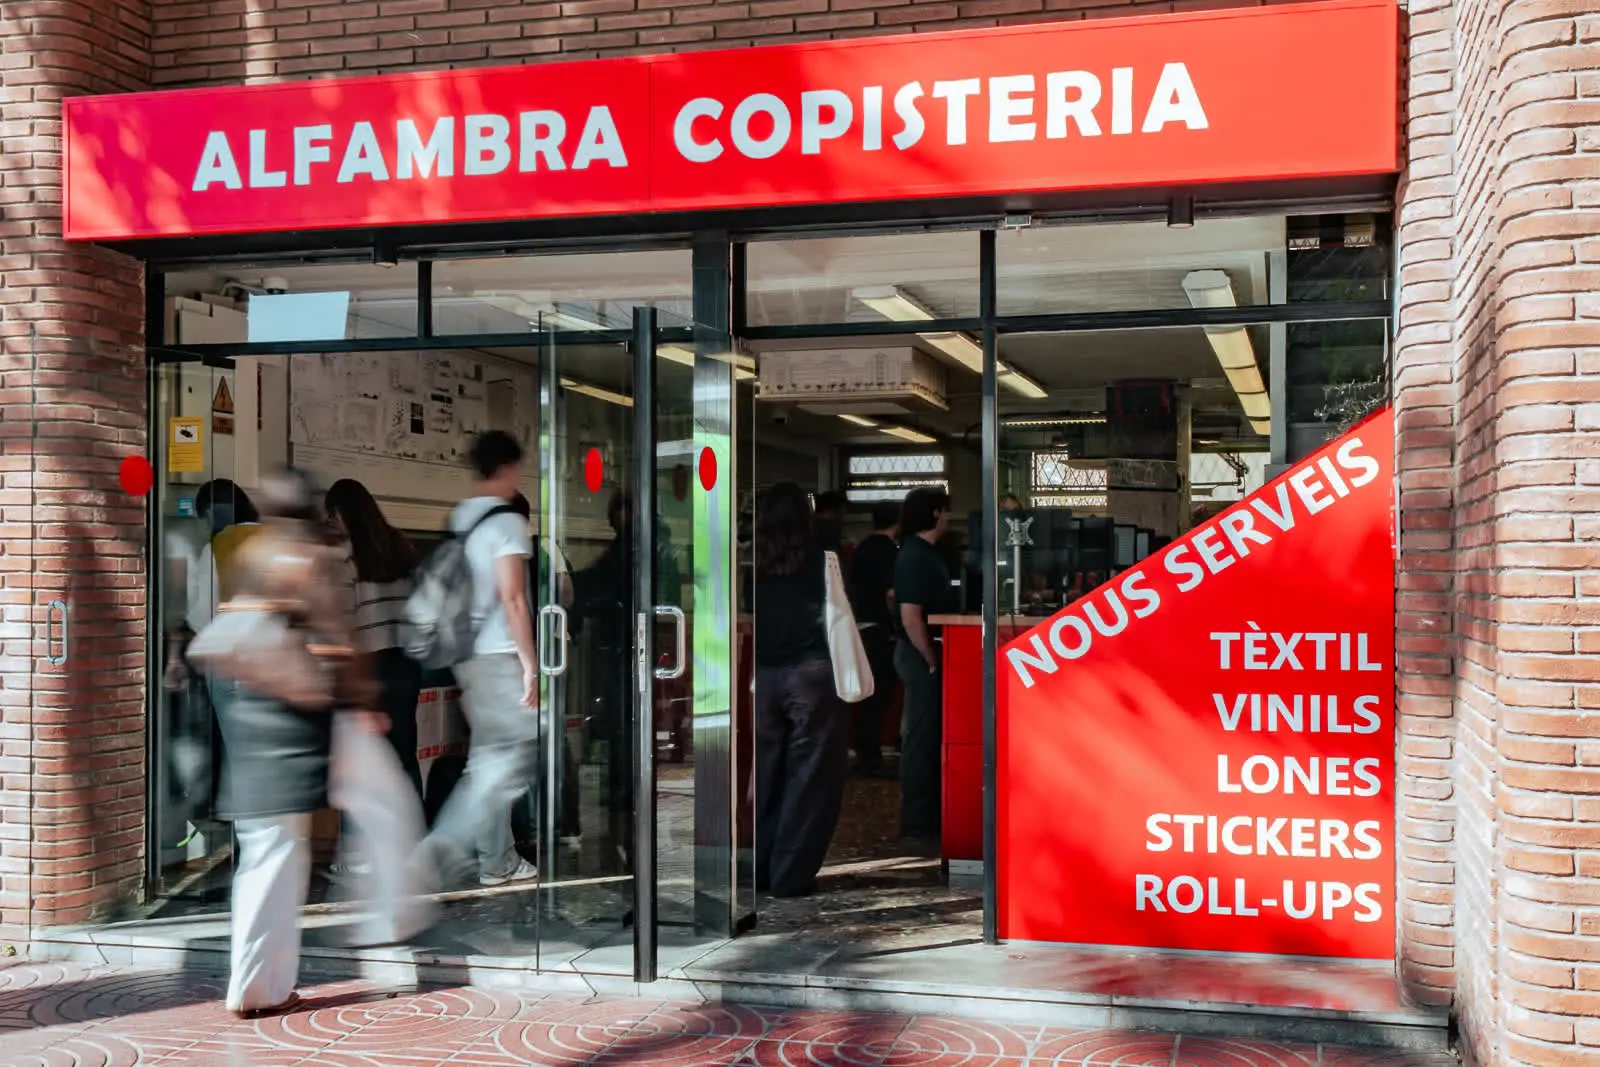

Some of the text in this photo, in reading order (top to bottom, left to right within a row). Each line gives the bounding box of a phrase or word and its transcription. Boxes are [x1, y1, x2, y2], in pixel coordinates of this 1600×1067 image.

[191, 62, 1209, 192] ALFAMBRA COPISTERIA
[1006, 437, 1380, 689] NOUS SERVEIS
[1209, 621, 1382, 671] TÈXTIL
[1212, 693, 1382, 733] VINILS
[1216, 753, 1382, 797] LONES
[1145, 812, 1383, 860] STICKERS
[1135, 873, 1383, 923] ROLL-UPS
